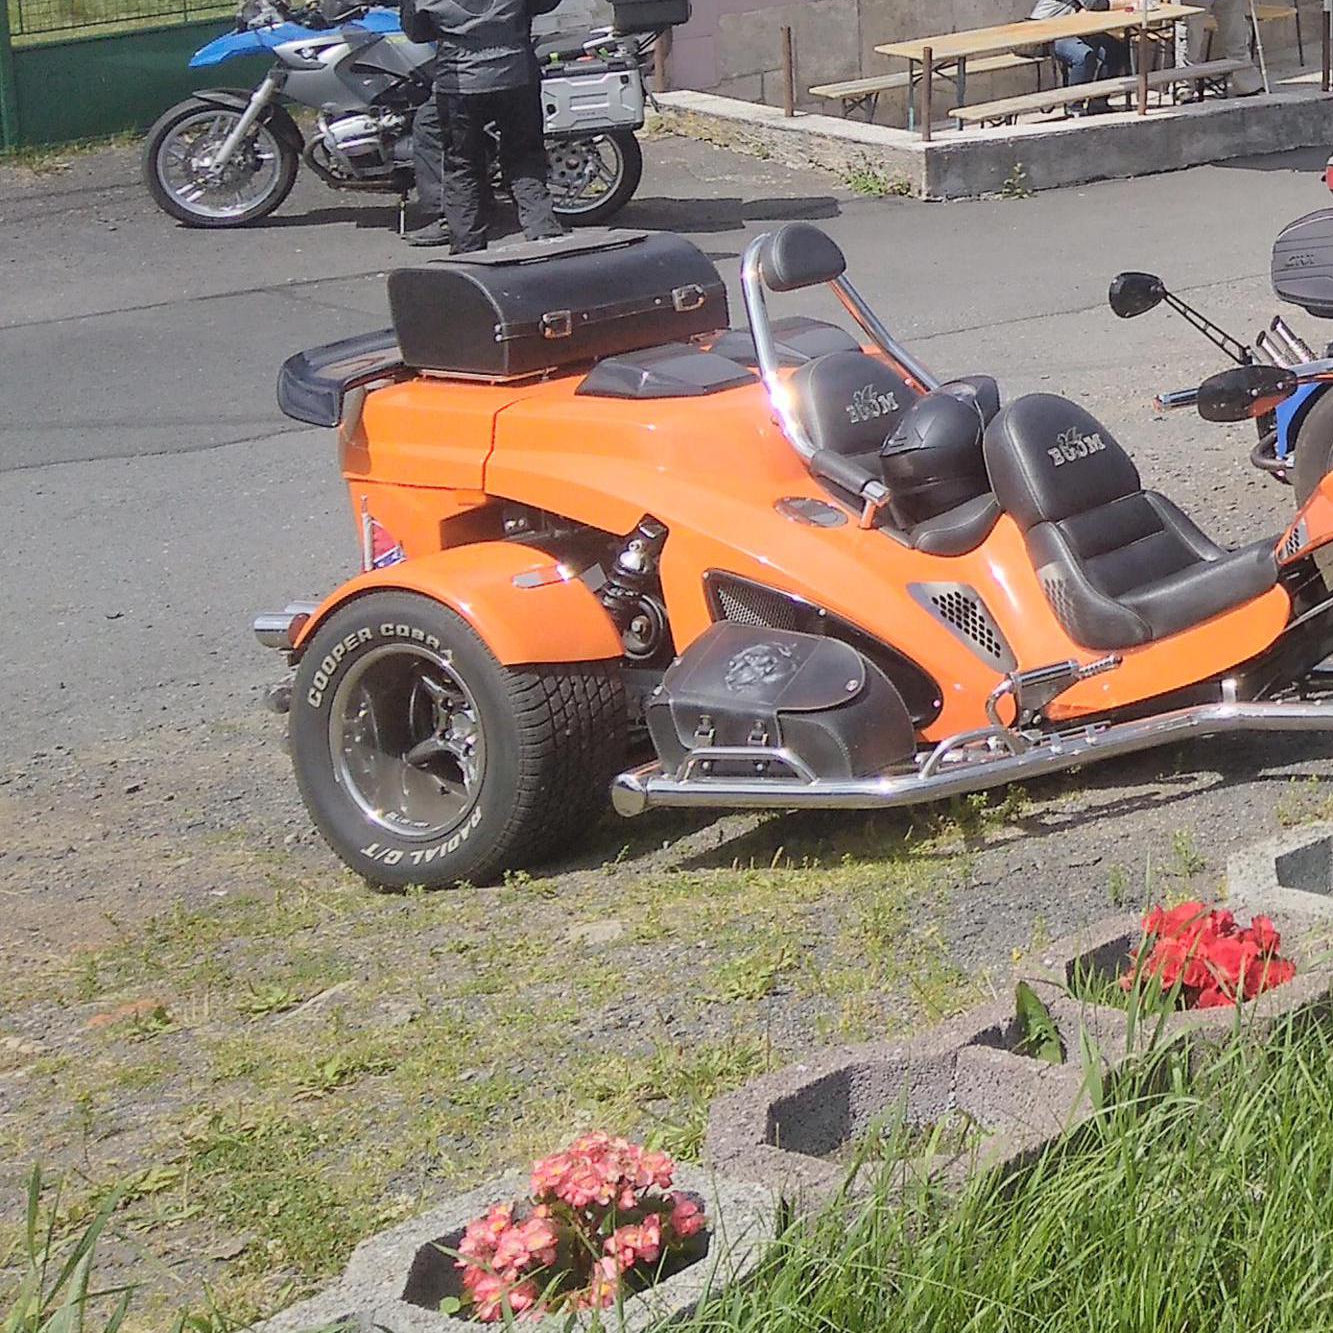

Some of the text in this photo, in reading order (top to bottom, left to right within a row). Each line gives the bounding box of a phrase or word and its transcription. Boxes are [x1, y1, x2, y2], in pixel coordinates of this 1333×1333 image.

[1047, 432, 1106, 467] BOOM
[307, 623, 454, 708] COOPER COBRA
[360, 842, 404, 865] G/T
[410, 805, 482, 865] RADIAL
